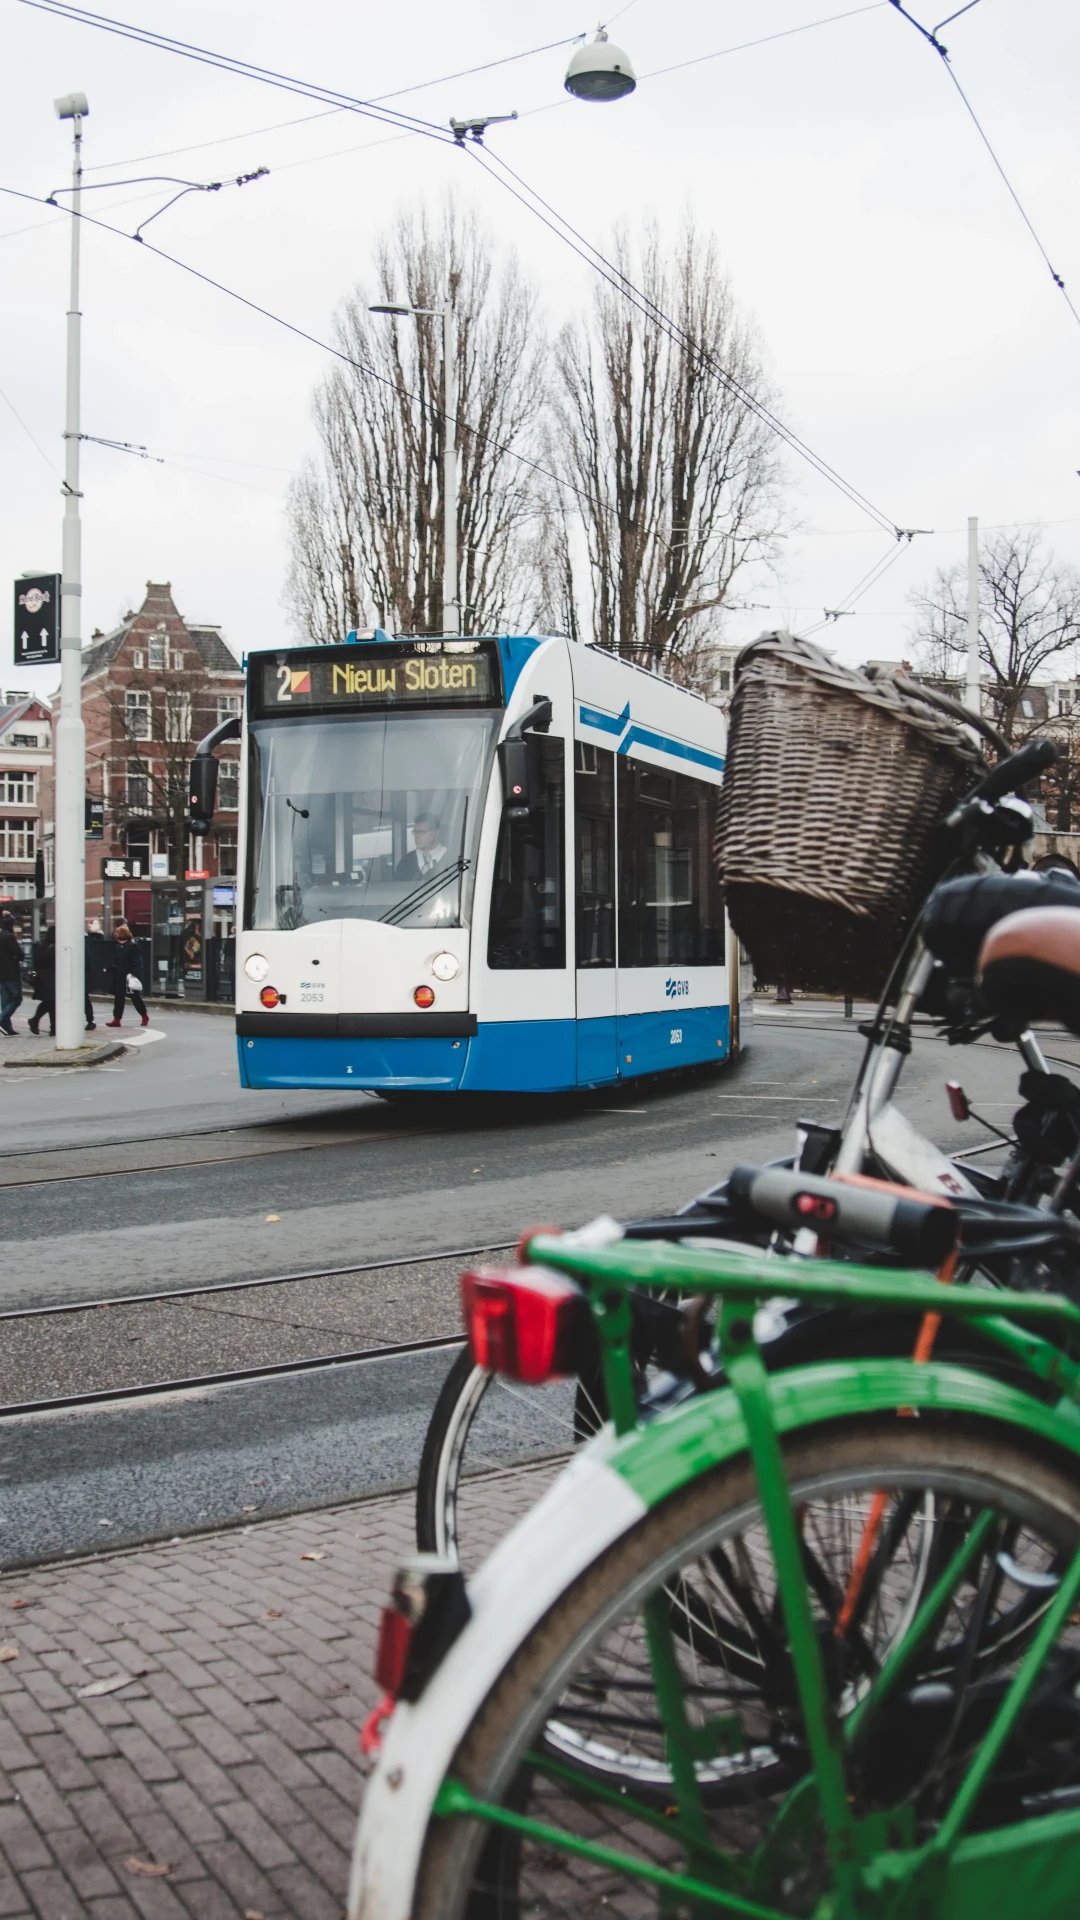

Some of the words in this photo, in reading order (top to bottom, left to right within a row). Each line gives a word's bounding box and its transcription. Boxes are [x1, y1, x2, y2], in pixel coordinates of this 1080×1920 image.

[276, 666, 292, 701] 2
[332, 664, 396, 694] Nieuw
[405, 658, 476, 690] Sloten
[677, 980, 689, 995] GVB
[300, 993, 324, 1002] 2053
[671, 1029, 683, 1044] 2053
